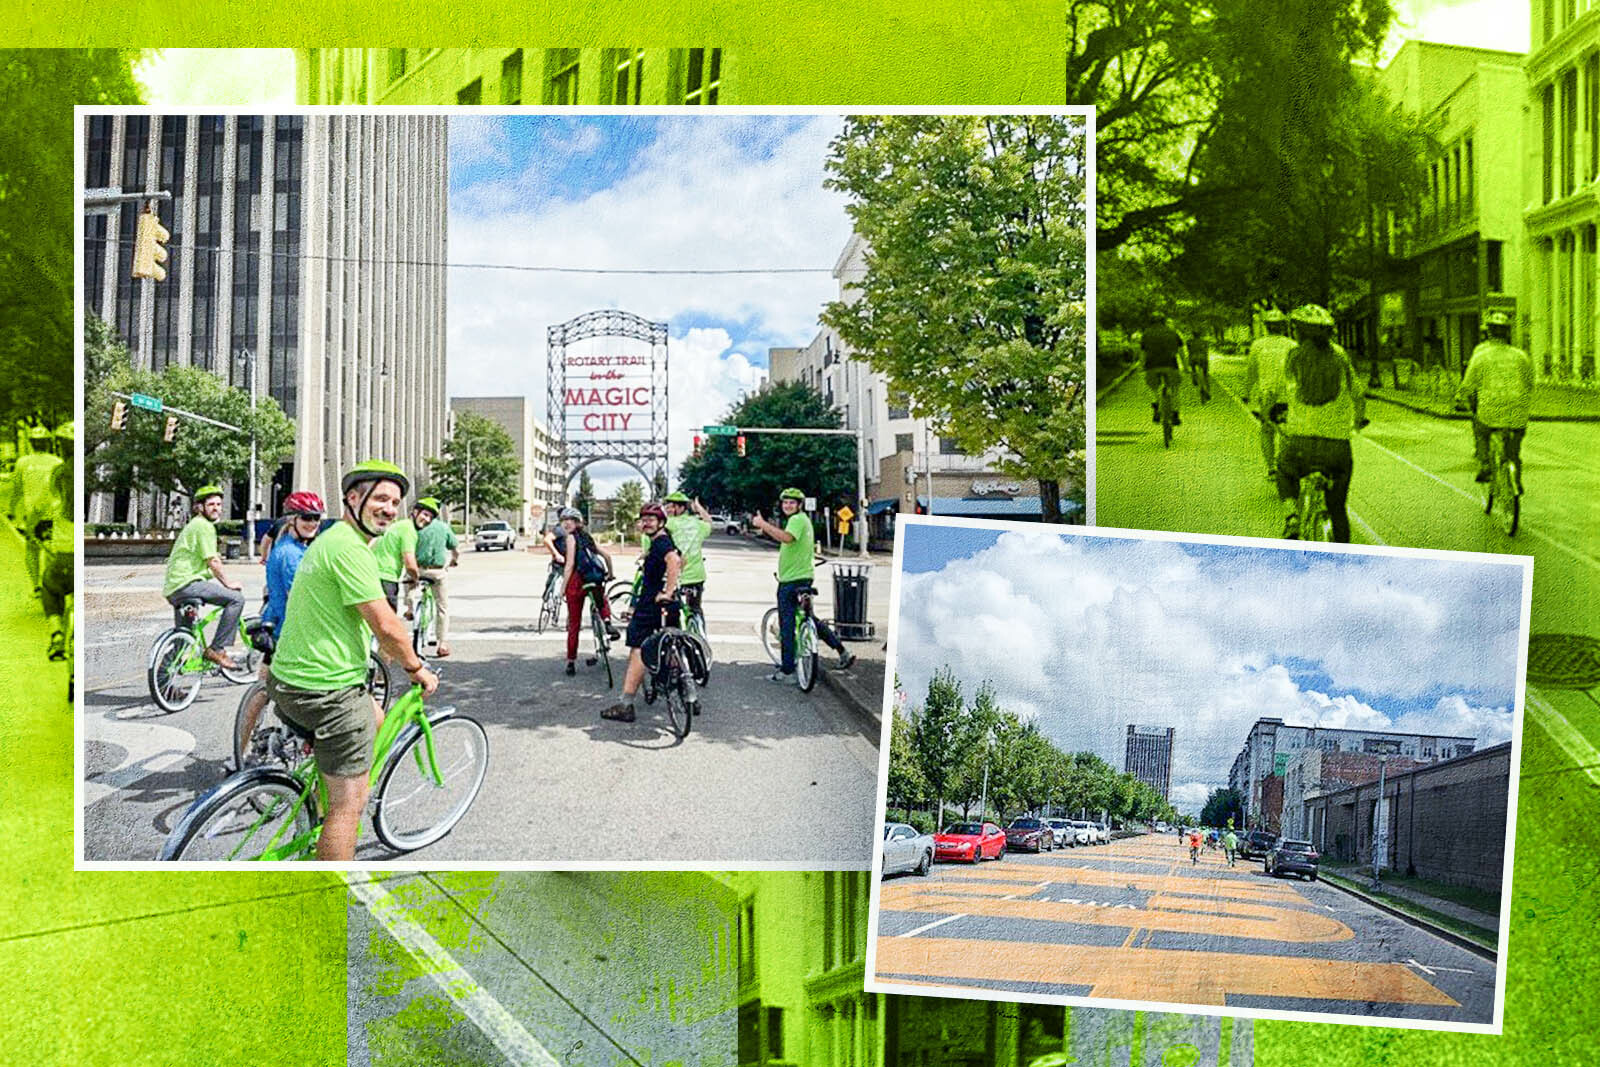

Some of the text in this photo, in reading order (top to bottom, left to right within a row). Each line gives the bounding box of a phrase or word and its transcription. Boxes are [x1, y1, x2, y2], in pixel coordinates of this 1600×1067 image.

[567, 356, 646, 366] ROTARY TRAIL
[589, 370, 625, 380] in the
[564, 387, 649, 406] MAGIC
[583, 413, 632, 431] CITY
